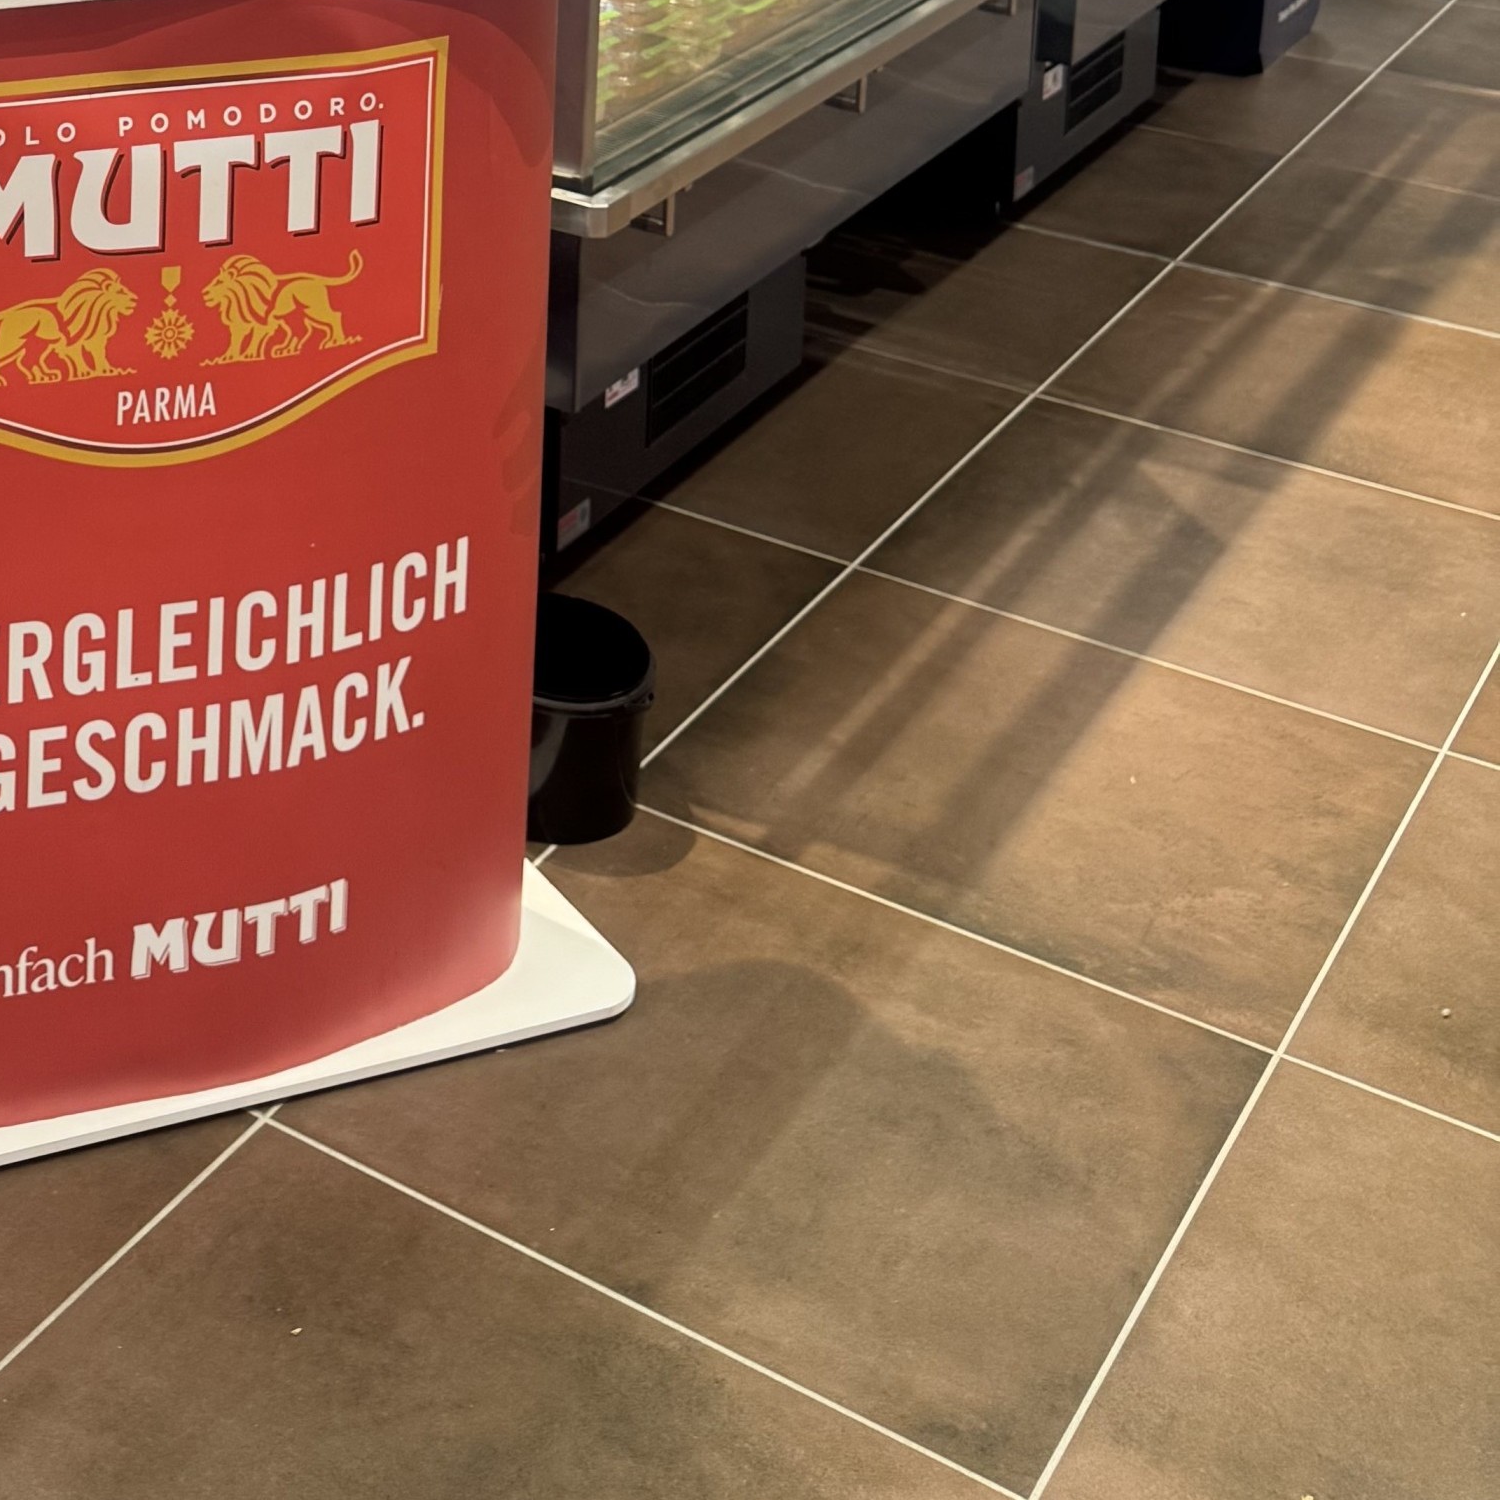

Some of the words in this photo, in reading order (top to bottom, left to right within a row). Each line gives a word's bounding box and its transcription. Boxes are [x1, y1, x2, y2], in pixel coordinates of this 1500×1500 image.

[118, 92, 385, 137] POMODORO.
[115, 381, 218, 426] PARMA
[129, 876, 349, 980] MUTTI
